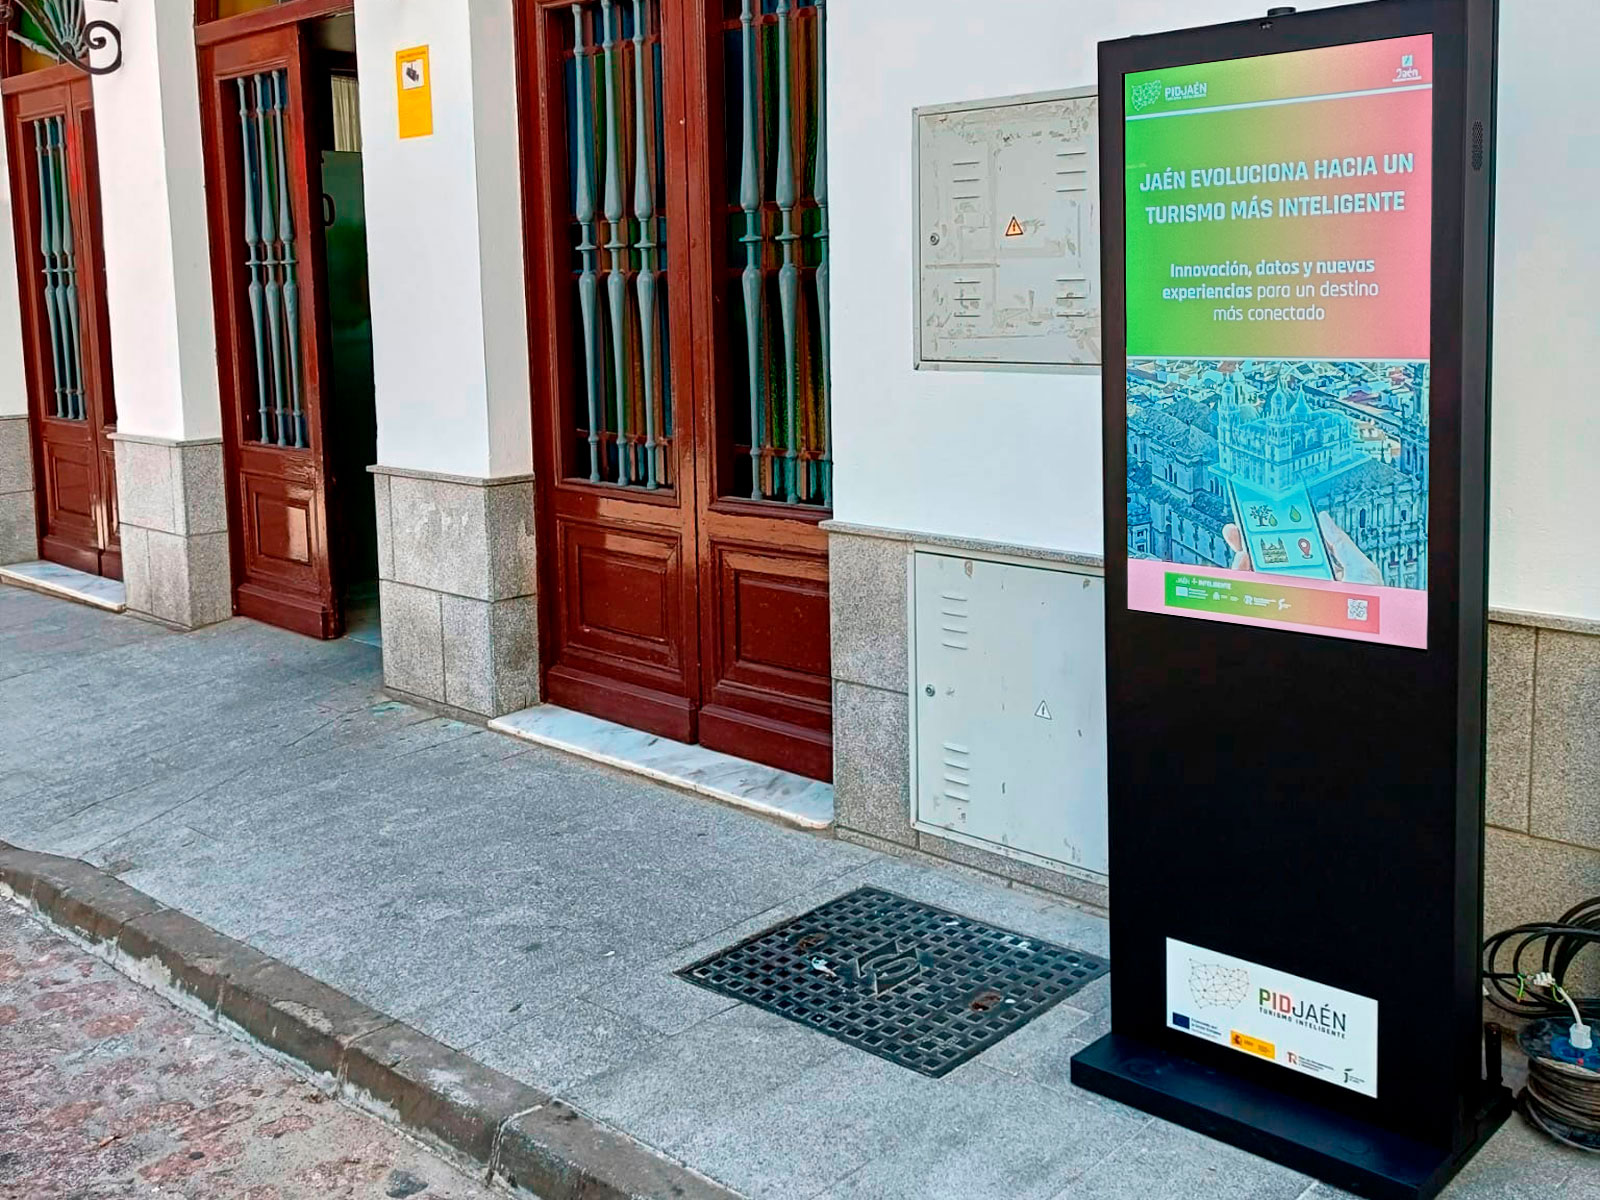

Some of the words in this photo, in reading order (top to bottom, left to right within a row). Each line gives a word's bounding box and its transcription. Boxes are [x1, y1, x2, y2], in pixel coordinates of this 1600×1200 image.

[1164, 81, 1208, 98] PIDJAÉN
[1139, 167, 1186, 192] JAÉN
[1190, 161, 1309, 189] EVOLUCIONA
[1313, 155, 1378, 180] HACIA
[1383, 152, 1415, 174] UN
[1145, 201, 1226, 225] TURISMO
[1230, 195, 1274, 220] MÁS
[1278, 191, 1406, 218] INTELIGENTE
[1170, 260, 1252, 278] Innovación,
[1256, 259, 1300, 275] datos
[1302, 261, 1313, 277] y
[1316, 259, 1375, 274] nuevas
[1162, 282, 1252, 302] experiencias
[1257, 285, 1291, 301] para
[1295, 284, 1315, 297] un
[1320, 280, 1379, 297] destino
[1213, 305, 1244, 321] más
[1247, 304, 1326, 321] conectado
[1259, 988, 1346, 1032] PIDJAÉN
[1259, 1006, 1293, 1022] TURISMO
[1295, 1018, 1346, 1039] INTELIGENTE
